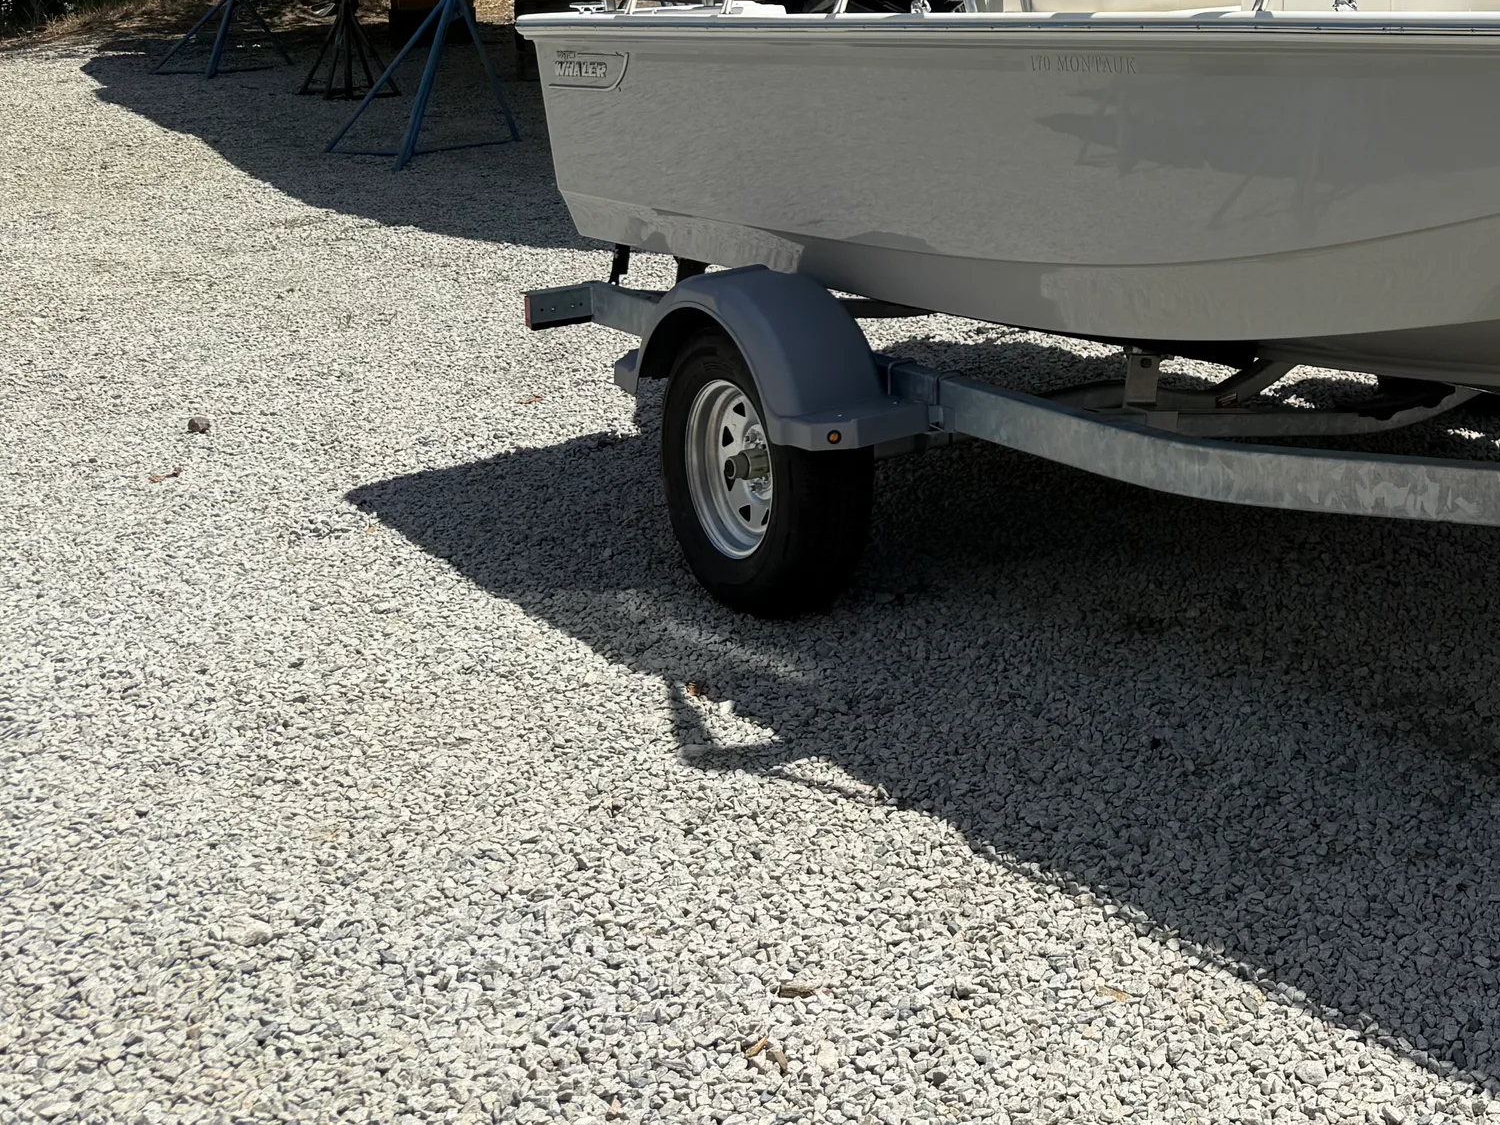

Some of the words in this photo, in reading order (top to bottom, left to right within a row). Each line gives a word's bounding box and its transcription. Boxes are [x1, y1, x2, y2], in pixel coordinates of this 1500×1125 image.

[555, 61, 607, 78] WHALER
[1030, 55, 1051, 72] 170
[1057, 55, 1137, 75] MONTAUK
